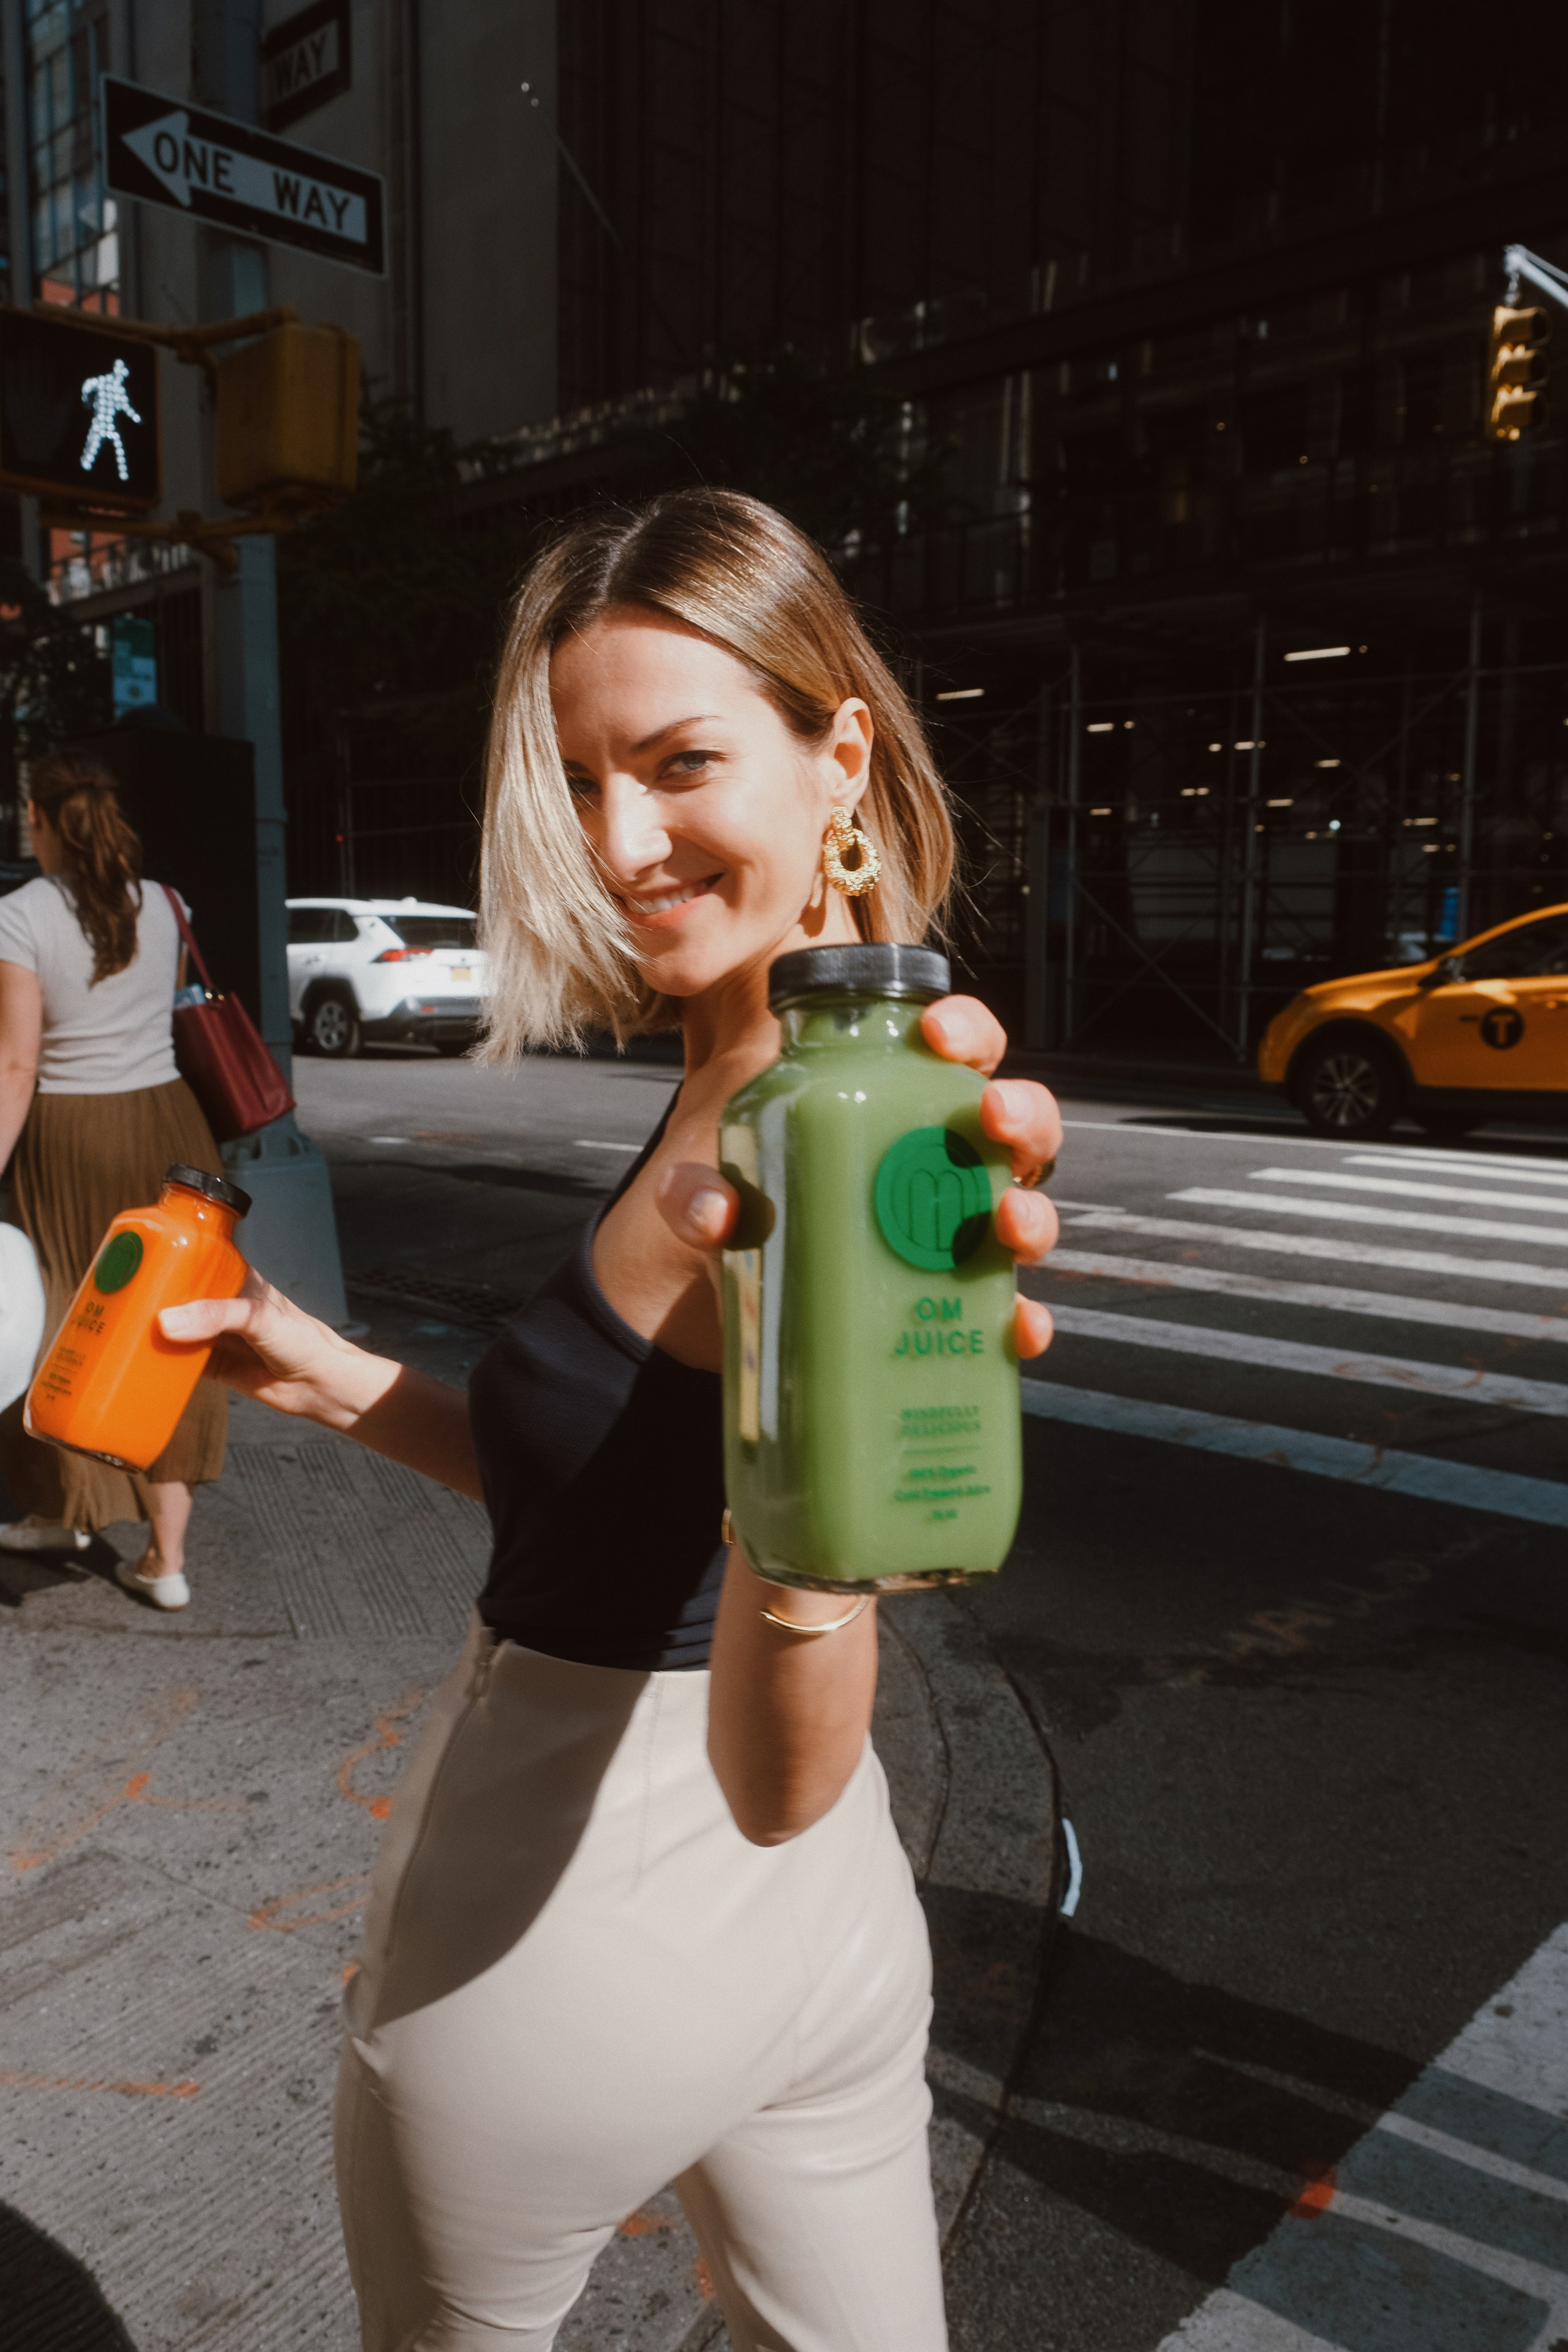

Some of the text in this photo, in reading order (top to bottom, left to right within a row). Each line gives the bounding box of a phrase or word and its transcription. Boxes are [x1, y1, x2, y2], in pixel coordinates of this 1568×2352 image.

[275, 32, 326, 95] WAY
[154, 131, 350, 231] ONE WAY
[86, 1301, 105, 1316] OM
[916, 1295, 962, 1321] OM
[894, 1329, 984, 1356] JUICE
